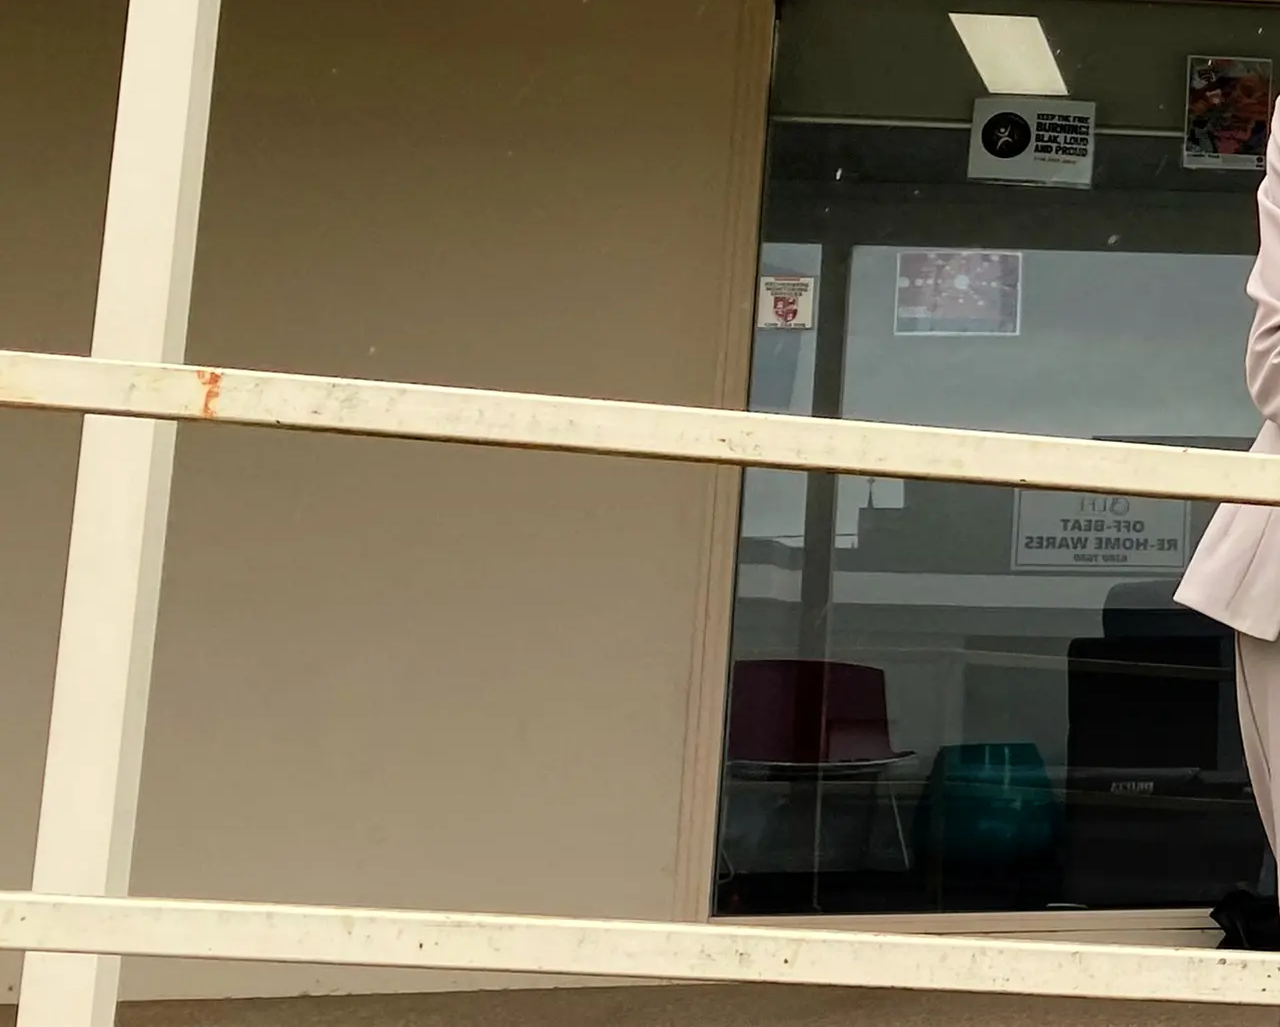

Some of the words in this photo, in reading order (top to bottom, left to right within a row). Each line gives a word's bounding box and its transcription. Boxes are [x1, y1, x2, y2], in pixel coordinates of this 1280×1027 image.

[1064, 136, 1089, 147] LOUD
[1034, 144, 1053, 154] AND
[1055, 146, 1088, 157] PROUD
